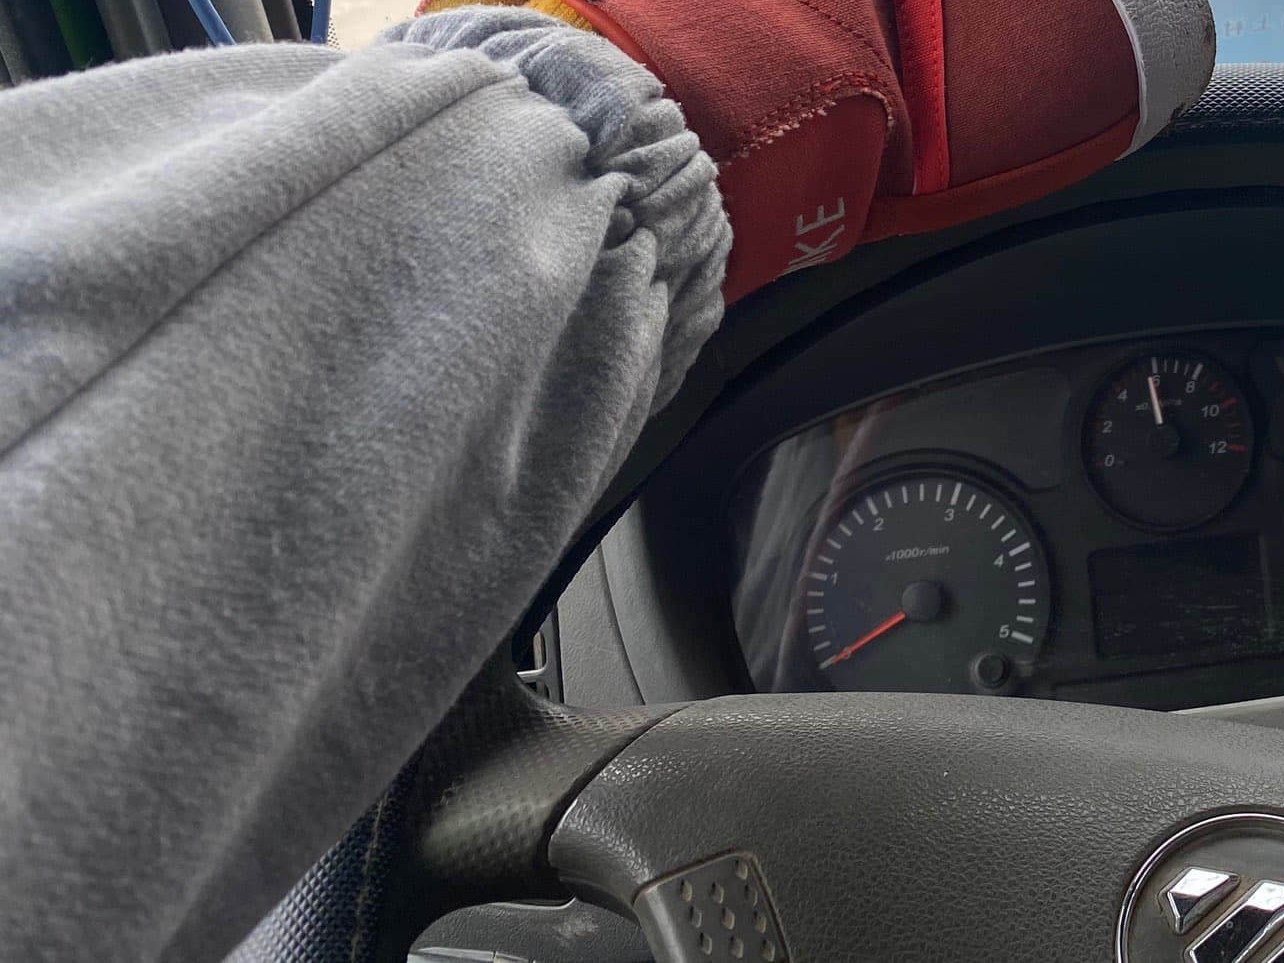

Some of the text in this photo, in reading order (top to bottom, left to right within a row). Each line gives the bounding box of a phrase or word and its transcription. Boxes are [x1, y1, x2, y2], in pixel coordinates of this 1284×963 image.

[1186, 381, 1196, 394] 8
[1117, 388, 1128, 401] 4
[1201, 404, 1220, 418] 10
[1102, 420, 1113, 434] 2
[1209, 440, 1227, 454] 12
[1104, 454, 1115, 467] 0
[944, 508, 954, 521] 3
[873, 518, 884, 531] 2
[993, 555, 1004, 567] 4
[830, 572, 838, 584] 1
[999, 624, 1009, 638] 5
